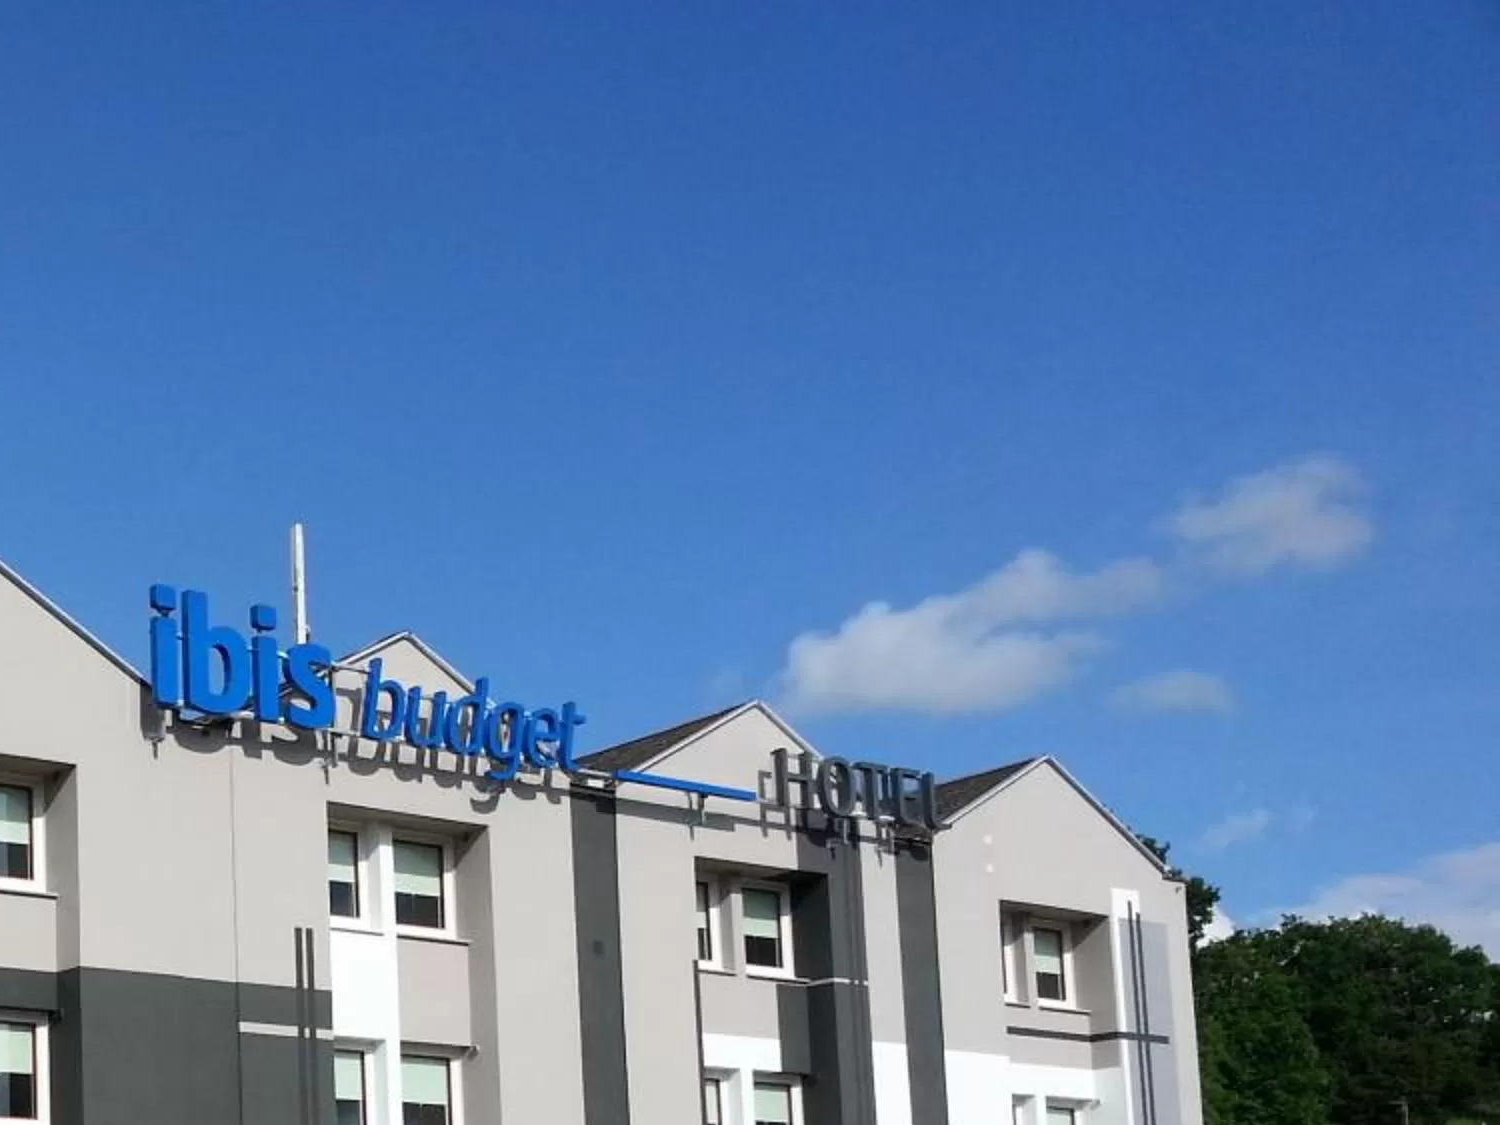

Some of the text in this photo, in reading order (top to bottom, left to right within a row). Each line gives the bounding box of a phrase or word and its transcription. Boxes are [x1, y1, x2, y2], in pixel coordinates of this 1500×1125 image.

[149, 583, 953, 830] ibis budget HOTEL
